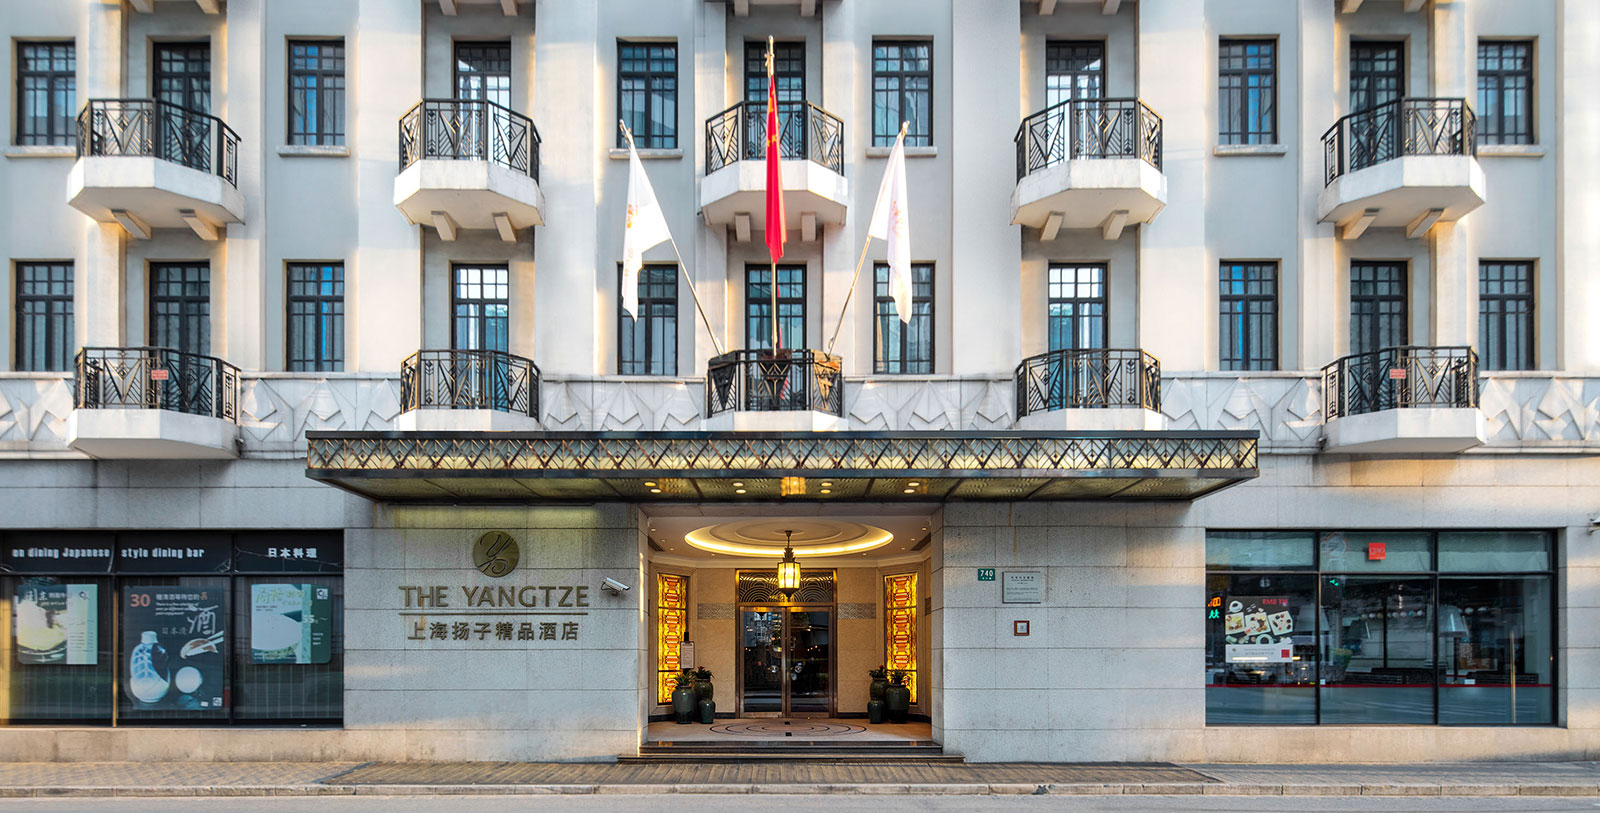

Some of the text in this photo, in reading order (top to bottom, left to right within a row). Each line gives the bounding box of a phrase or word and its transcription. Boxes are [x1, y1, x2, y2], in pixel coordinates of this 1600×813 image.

[27, 547, 60, 559] dining
[62, 547, 110, 559] Japanese
[121, 547, 205, 559] style dining bar
[268, 547, 318, 559] 日本料理
[130, 594, 151, 607] 30
[399, 586, 589, 607] THE YANGTZE
[407, 621, 579, 641] 上海扬子精品酒店
